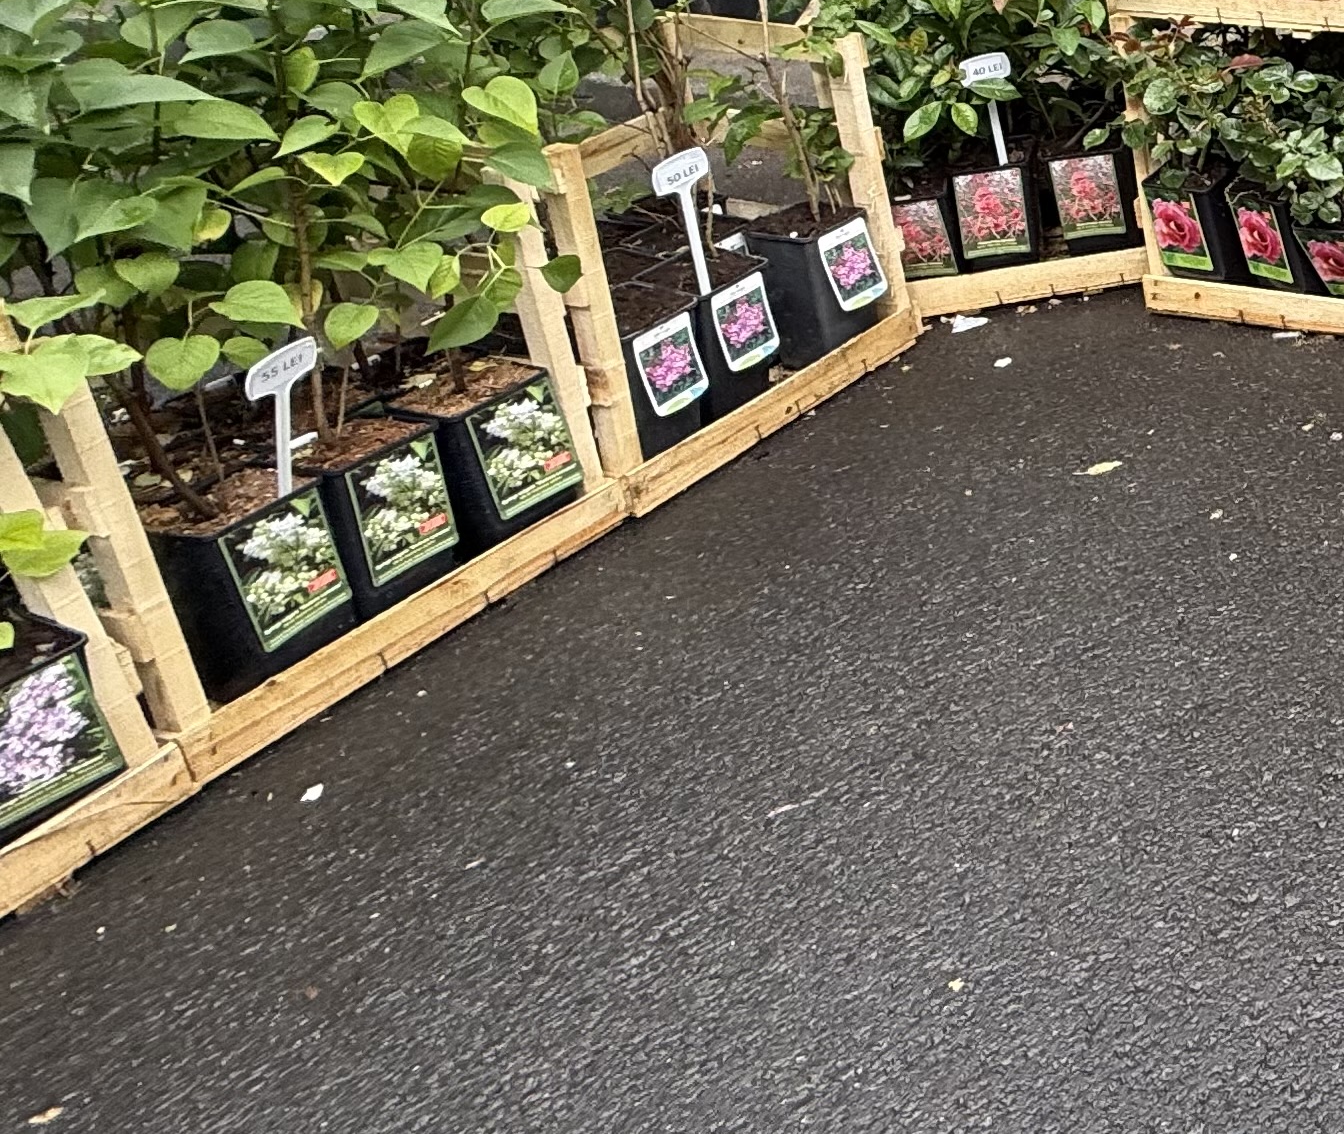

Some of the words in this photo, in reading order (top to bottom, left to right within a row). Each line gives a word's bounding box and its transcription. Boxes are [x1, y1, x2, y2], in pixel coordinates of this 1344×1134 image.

[972, 68, 986, 76] 40
[988, 63, 1003, 73] LEI
[666, 173, 682, 186] 50
[683, 163, 699, 178] LEI
[261, 368, 279, 383] 55
[282, 353, 304, 372] LEI
